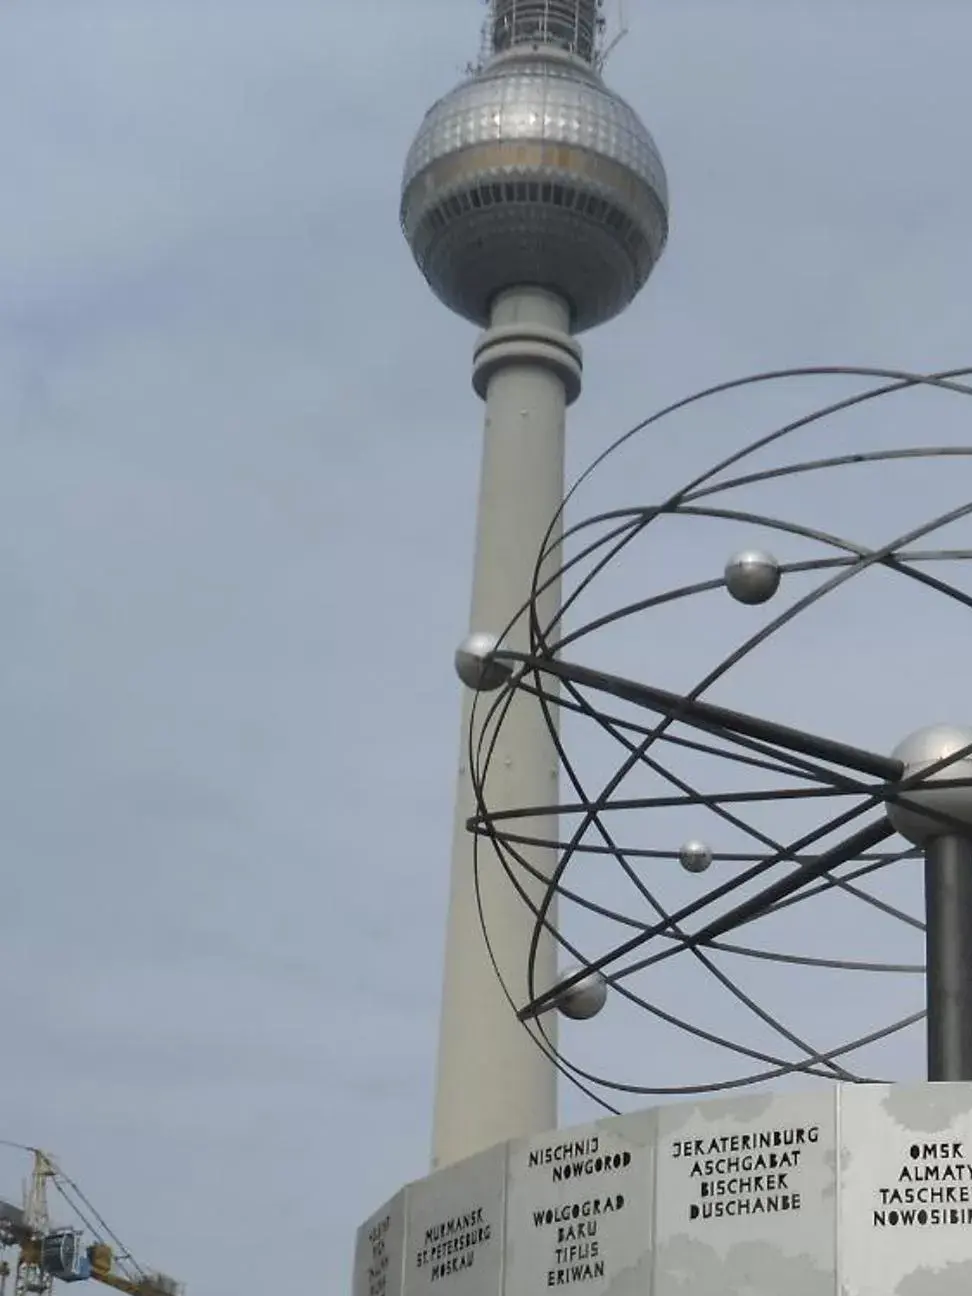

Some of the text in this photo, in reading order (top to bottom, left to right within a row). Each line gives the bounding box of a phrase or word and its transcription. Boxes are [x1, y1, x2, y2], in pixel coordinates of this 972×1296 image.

[528, 1137, 599, 1167] NISCHNIJ
[672, 1127, 819, 1159] JEKATERINBURG
[910, 1143, 963, 1160] OMSK
[552, 1152, 632, 1182] NOWGOROD
[690, 1150, 801, 1177] ASCHGABAT
[701, 1173, 789, 1197] BISCHKEK
[533, 1194, 625, 1227] WOLGOGRAD
[689, 1193, 801, 1220] DUSCHANBE
[557, 1220, 598, 1243] BAKU
[431, 1250, 475, 1282] MOSKAU
[555, 1241, 599, 1264] TIFLIS
[547, 1261, 605, 1287] ERIWAN
